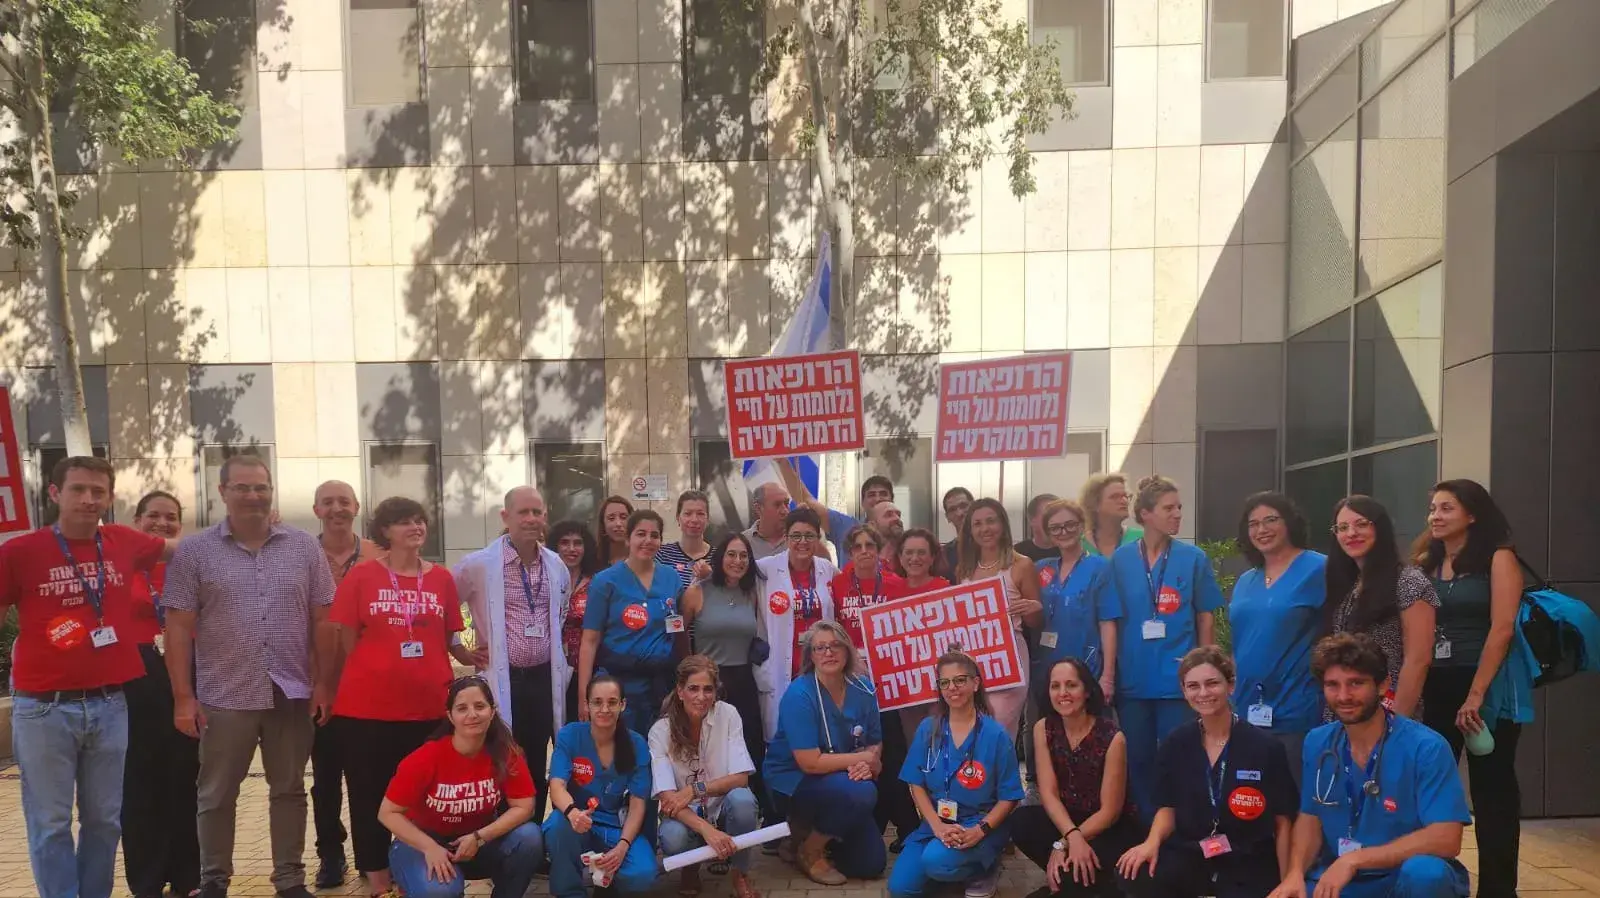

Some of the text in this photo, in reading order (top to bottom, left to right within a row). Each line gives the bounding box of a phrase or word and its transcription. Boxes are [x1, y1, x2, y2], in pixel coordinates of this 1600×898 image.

[734, 358, 853, 393] הרופאות
[947, 361, 1063, 395] הרופאות
[736, 386, 854, 421] נלחמות על חיי
[946, 389, 1059, 424] נלחמות על חיי
[738, 418, 857, 451] הדמוקרטיה
[942, 423, 1058, 455] הדמוקרטיה
[870, 587, 1000, 639] הרופאות
[875, 639, 906, 668] חיי
[905, 632, 932, 664] על
[880, 650, 1012, 700] הדרטיה
[435, 778, 495, 799] אין בריאות
